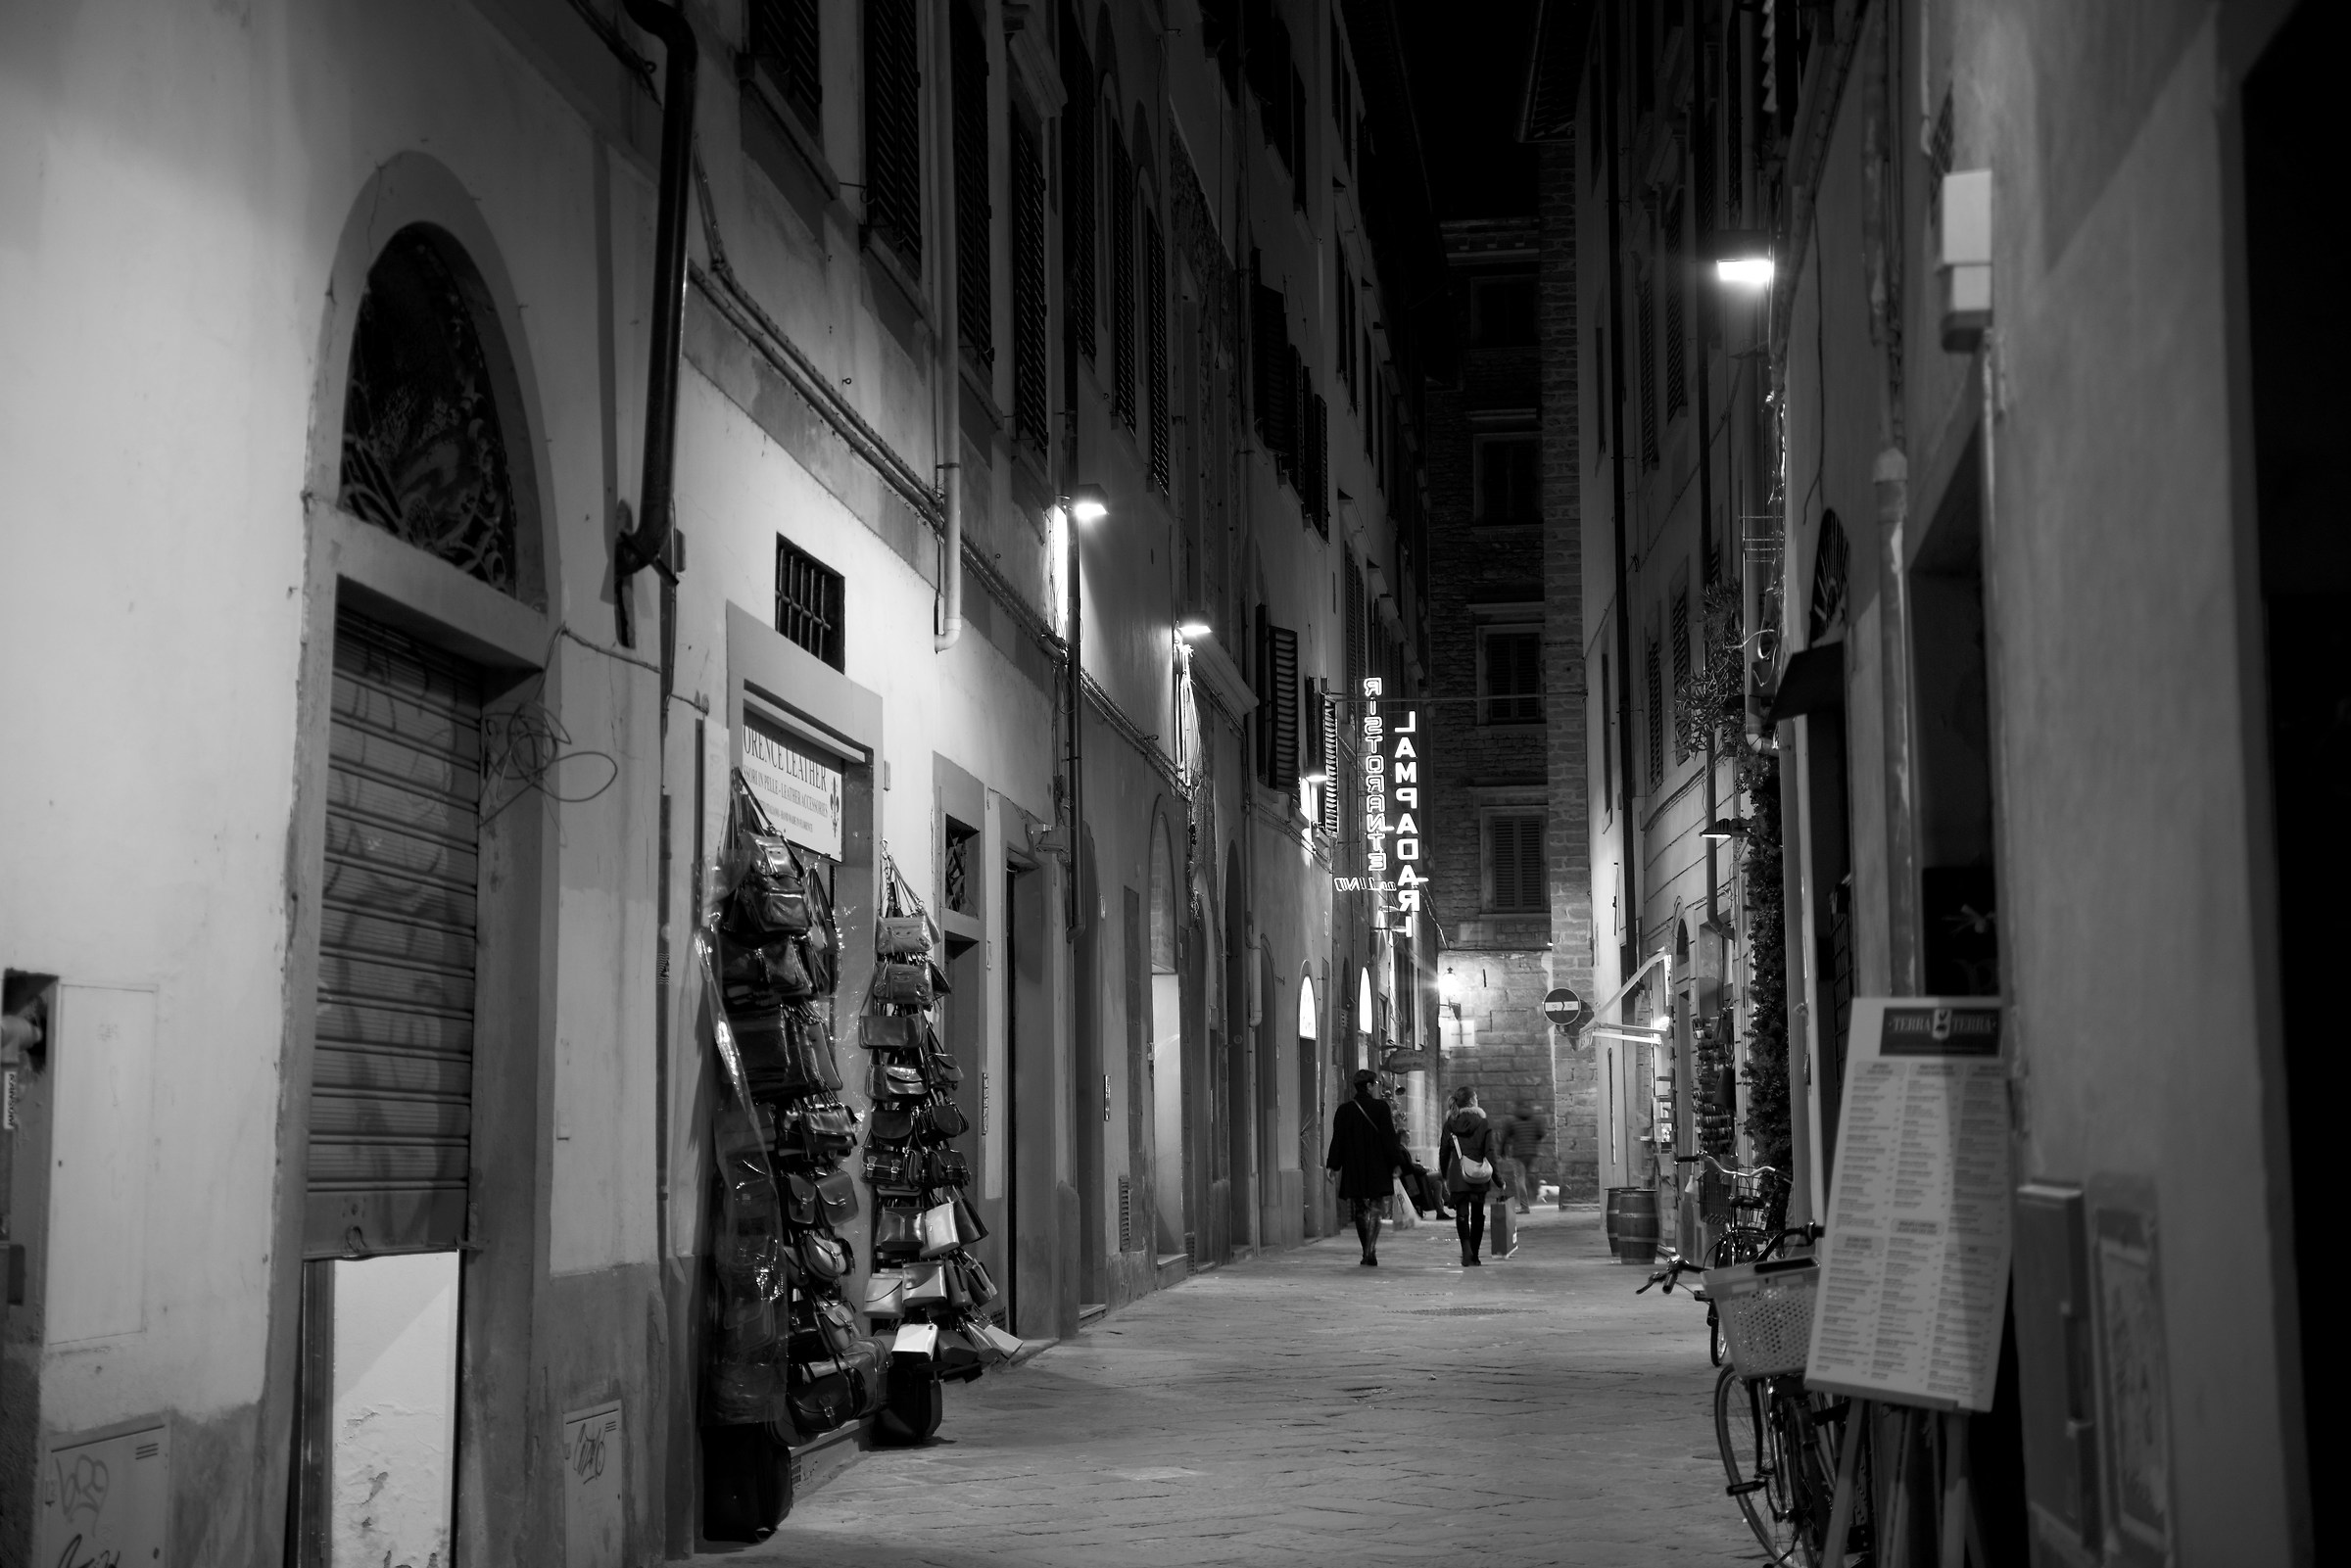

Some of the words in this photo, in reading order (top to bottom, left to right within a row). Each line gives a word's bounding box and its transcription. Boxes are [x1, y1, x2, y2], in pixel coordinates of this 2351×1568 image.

[786, 743, 827, 792] LEATHER
[781, 783, 801, 805] LEATHER
[1893, 1016, 1931, 1033] TERRA
[1952, 1016, 1991, 1033] TERRA
